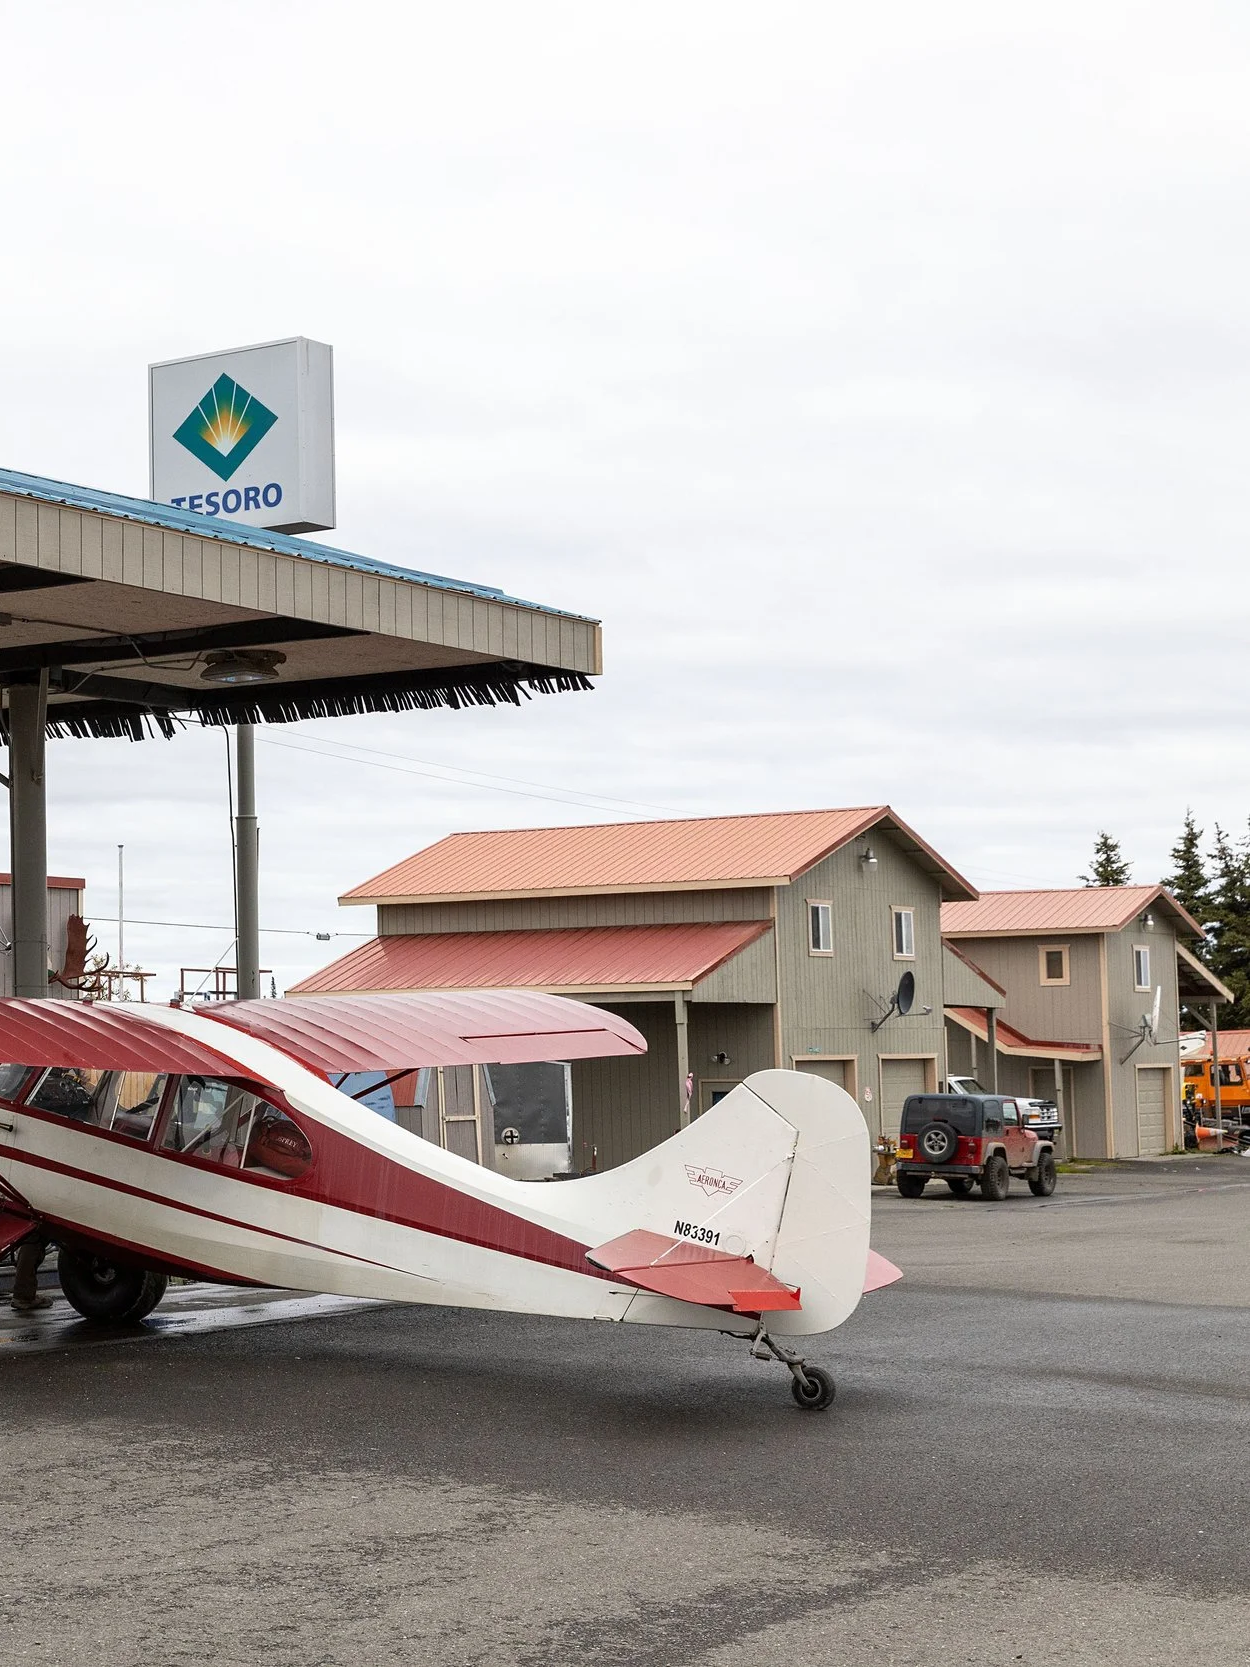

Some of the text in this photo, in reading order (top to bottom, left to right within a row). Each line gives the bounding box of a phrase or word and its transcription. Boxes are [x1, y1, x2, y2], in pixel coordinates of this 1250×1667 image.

[276, 1136, 298, 1148] SPREY
[696, 1174, 727, 1191] AERONCA
[673, 1220, 721, 1246] N83391
